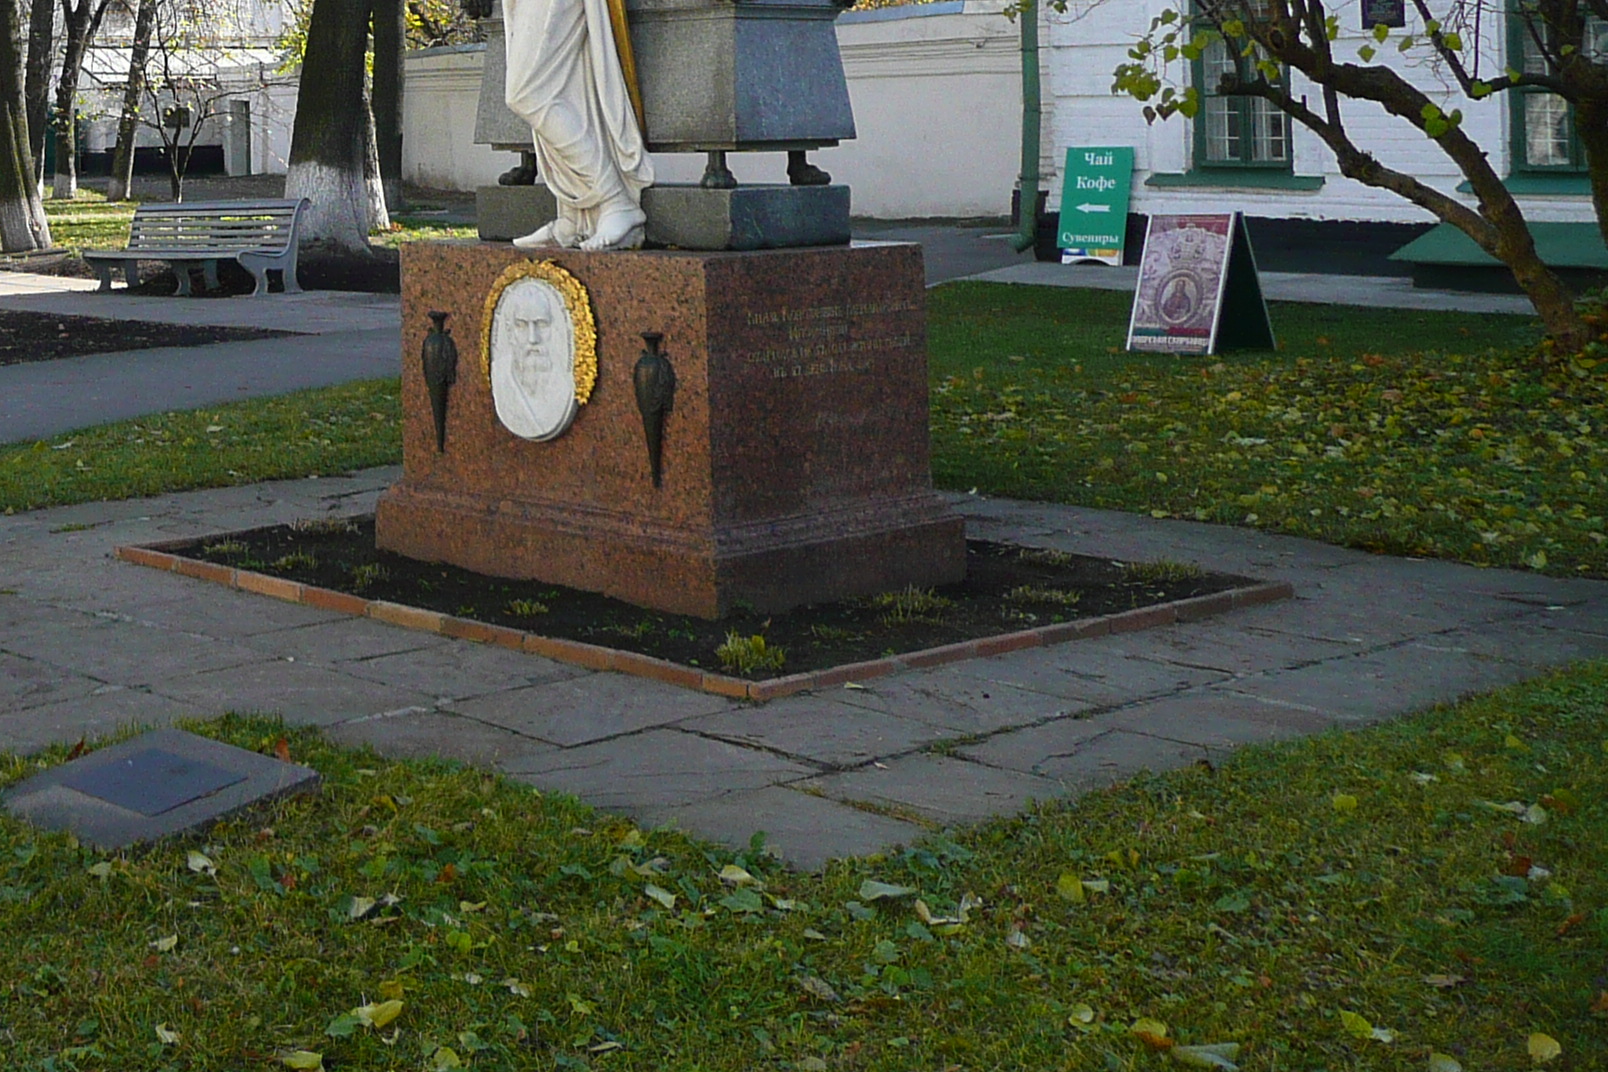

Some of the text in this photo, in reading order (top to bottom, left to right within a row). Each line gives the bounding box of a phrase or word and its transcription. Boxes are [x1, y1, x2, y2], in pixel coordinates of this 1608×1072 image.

[1084, 151, 1113, 166] Чай
[1076, 175, 1116, 192] Кофе
[1062, 231, 1119, 246] Сувениры
